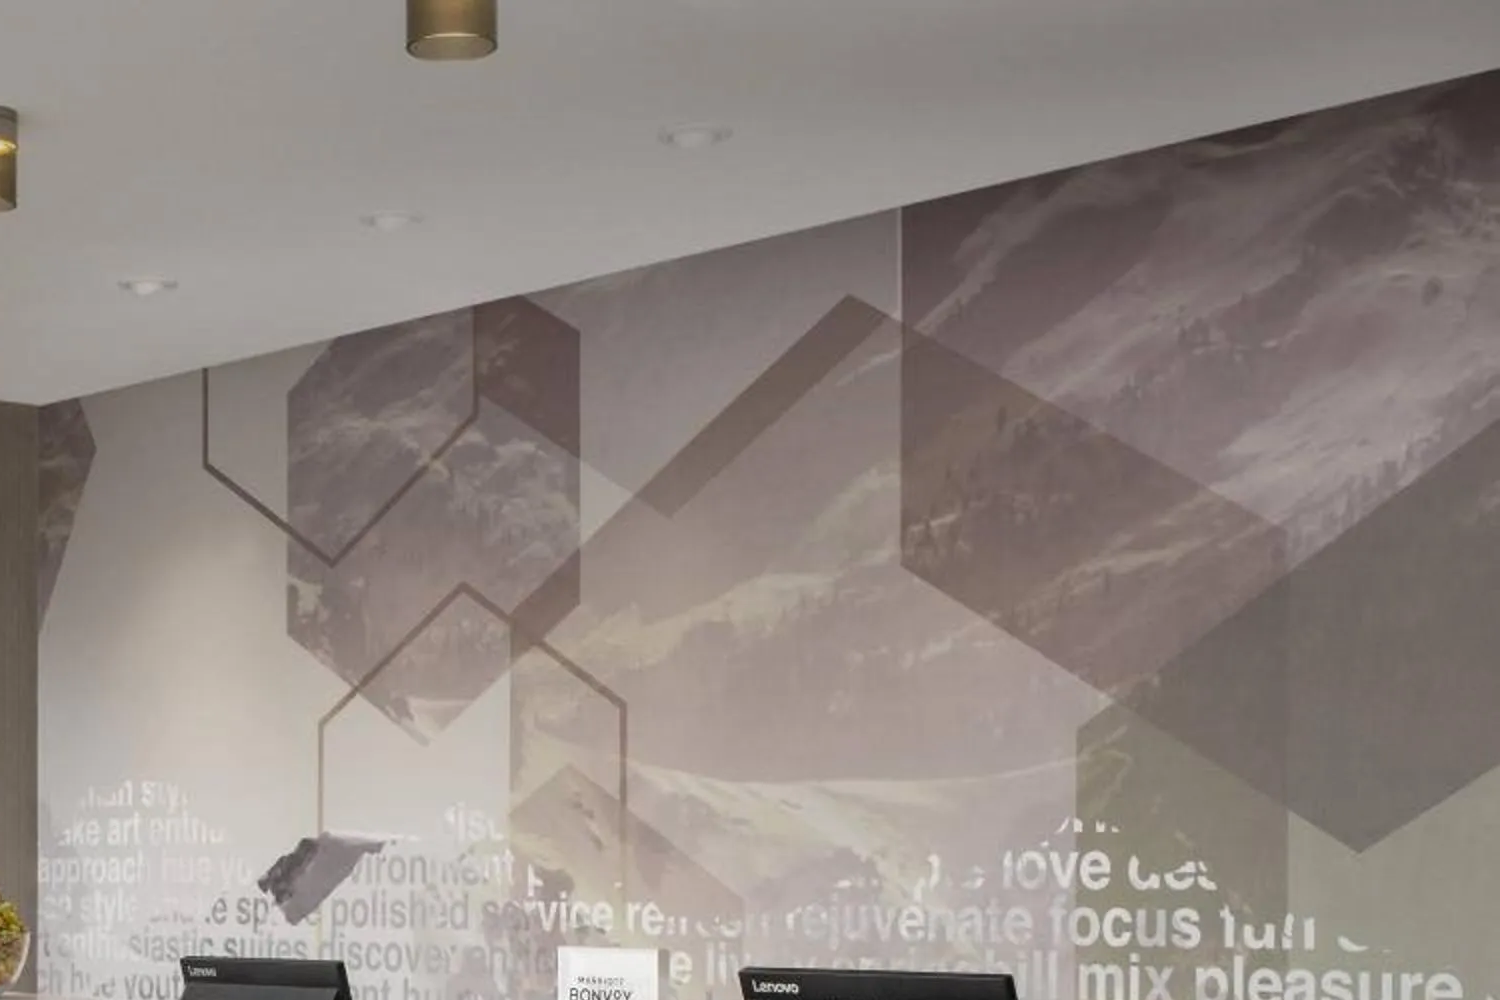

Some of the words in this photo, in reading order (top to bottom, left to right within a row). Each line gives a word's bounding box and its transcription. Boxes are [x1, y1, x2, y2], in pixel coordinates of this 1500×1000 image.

[107, 811, 141, 846] art
[39, 848, 148, 888] approach
[785, 895, 1034, 952] rejuvenate
[1048, 893, 1202, 949] focus
[751, 979, 799, 994] Lenovo
